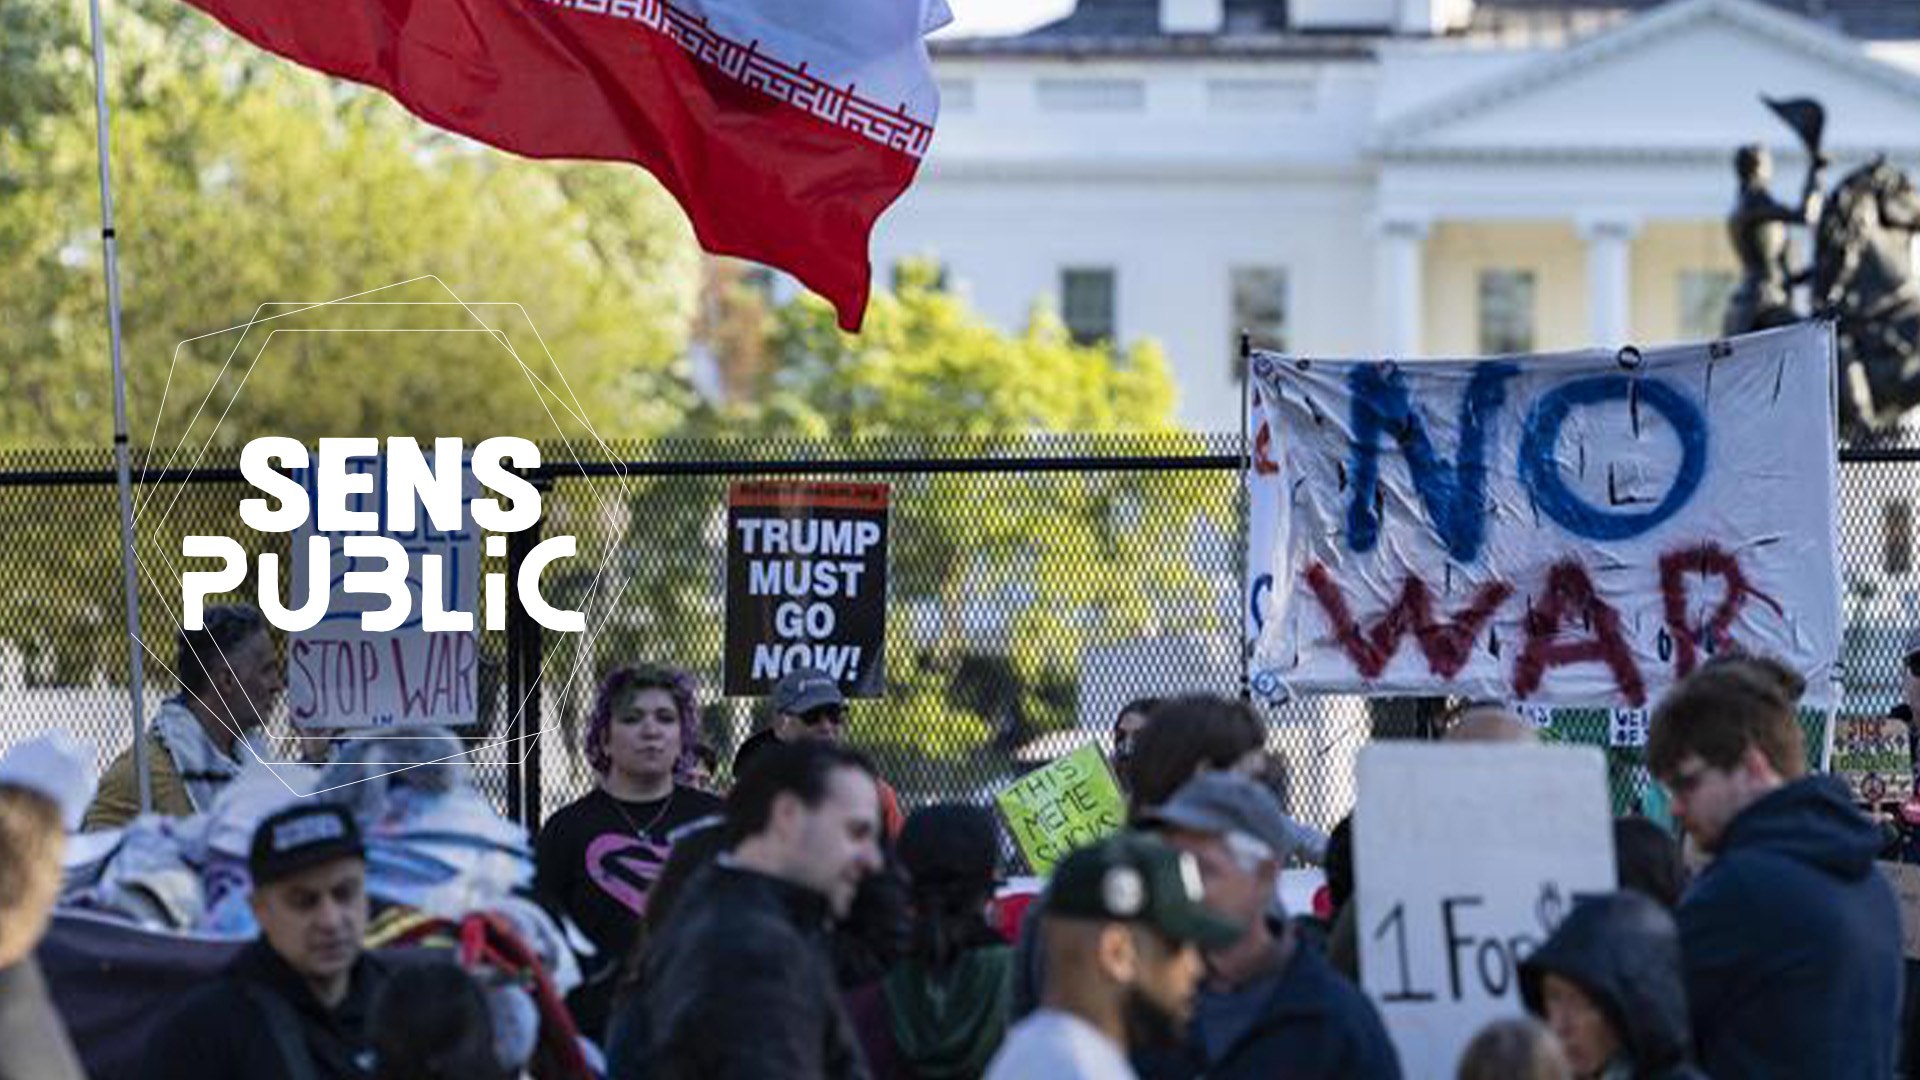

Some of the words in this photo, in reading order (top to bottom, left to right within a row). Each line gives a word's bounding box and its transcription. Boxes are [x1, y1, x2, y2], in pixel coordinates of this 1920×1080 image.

[1346, 361, 1708, 563] NO
[737, 518, 881, 555] TRUMP
[750, 560, 865, 597] MUST
[775, 602, 836, 638] GO
[1306, 540, 1784, 706] WAR
[292, 638, 379, 719] STOP
[391, 632, 476, 718] WAR
[752, 643, 861, 682] NOW!
[1007, 759, 1078, 800] THIS
[1022, 780, 1099, 841] MEME
[1373, 896, 1436, 1003] 1
